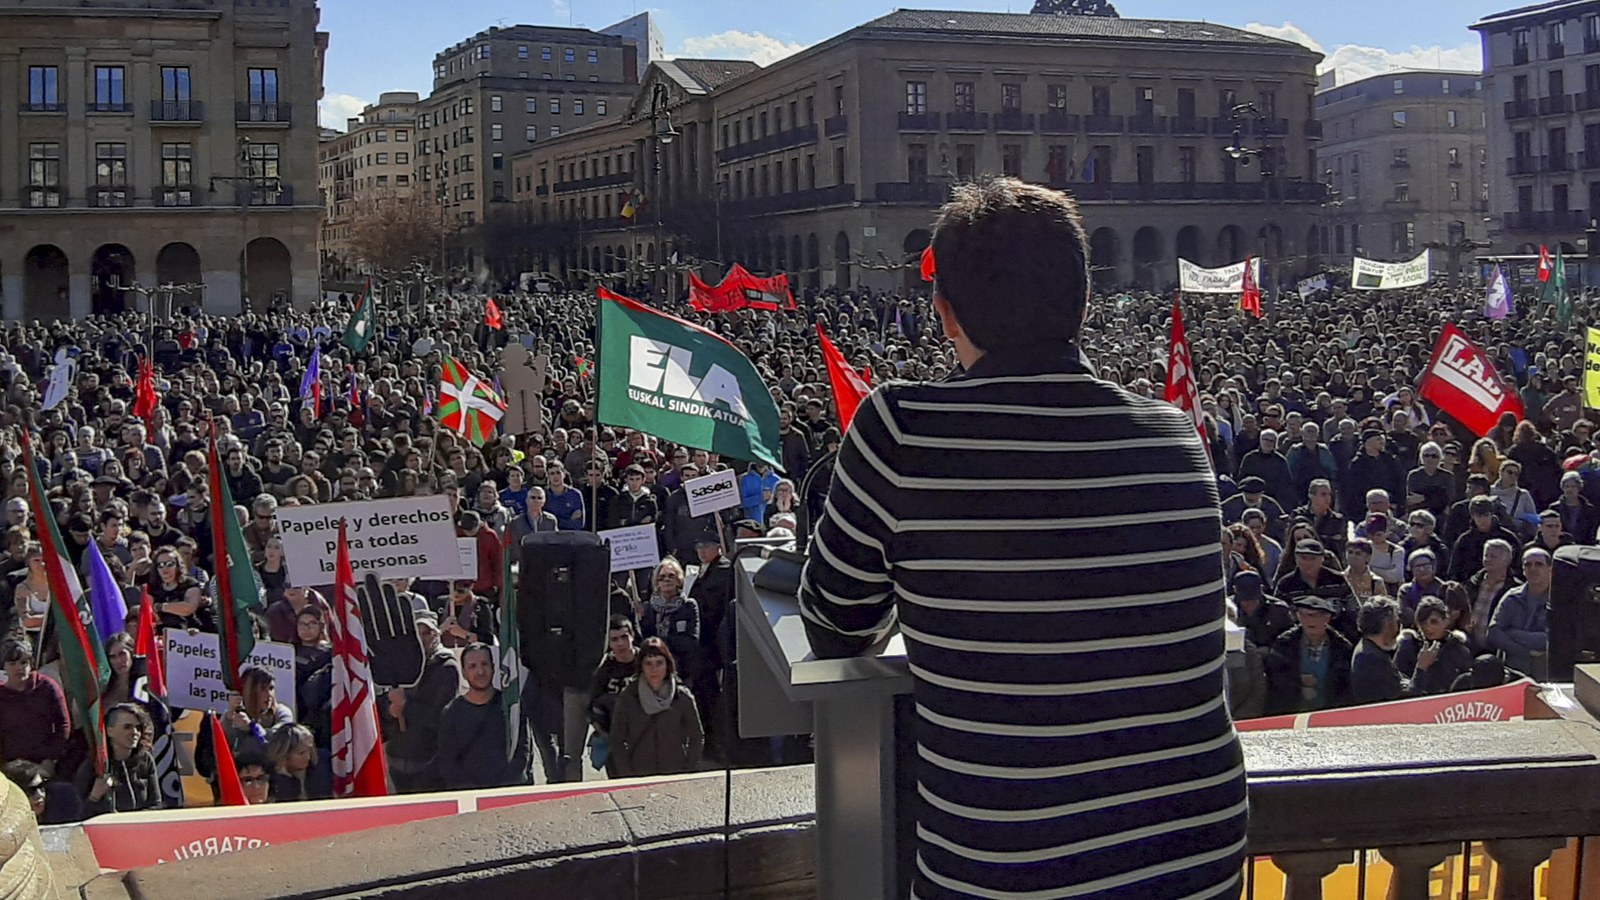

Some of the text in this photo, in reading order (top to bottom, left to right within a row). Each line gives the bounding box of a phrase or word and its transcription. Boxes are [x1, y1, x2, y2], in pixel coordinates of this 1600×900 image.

[629, 335, 749, 420] ELA
[628, 388, 747, 429] EUSKAL SINDIKATUA
[691, 479, 733, 498] sasoia
[353, 517, 362, 532] y
[369, 509, 450, 527] derechos
[325, 532, 419, 554] pra todas
[319, 558, 337, 572] la
[168, 639, 217, 659] Papeles
[194, 666, 222, 680] para
[189, 682, 207, 698] las
